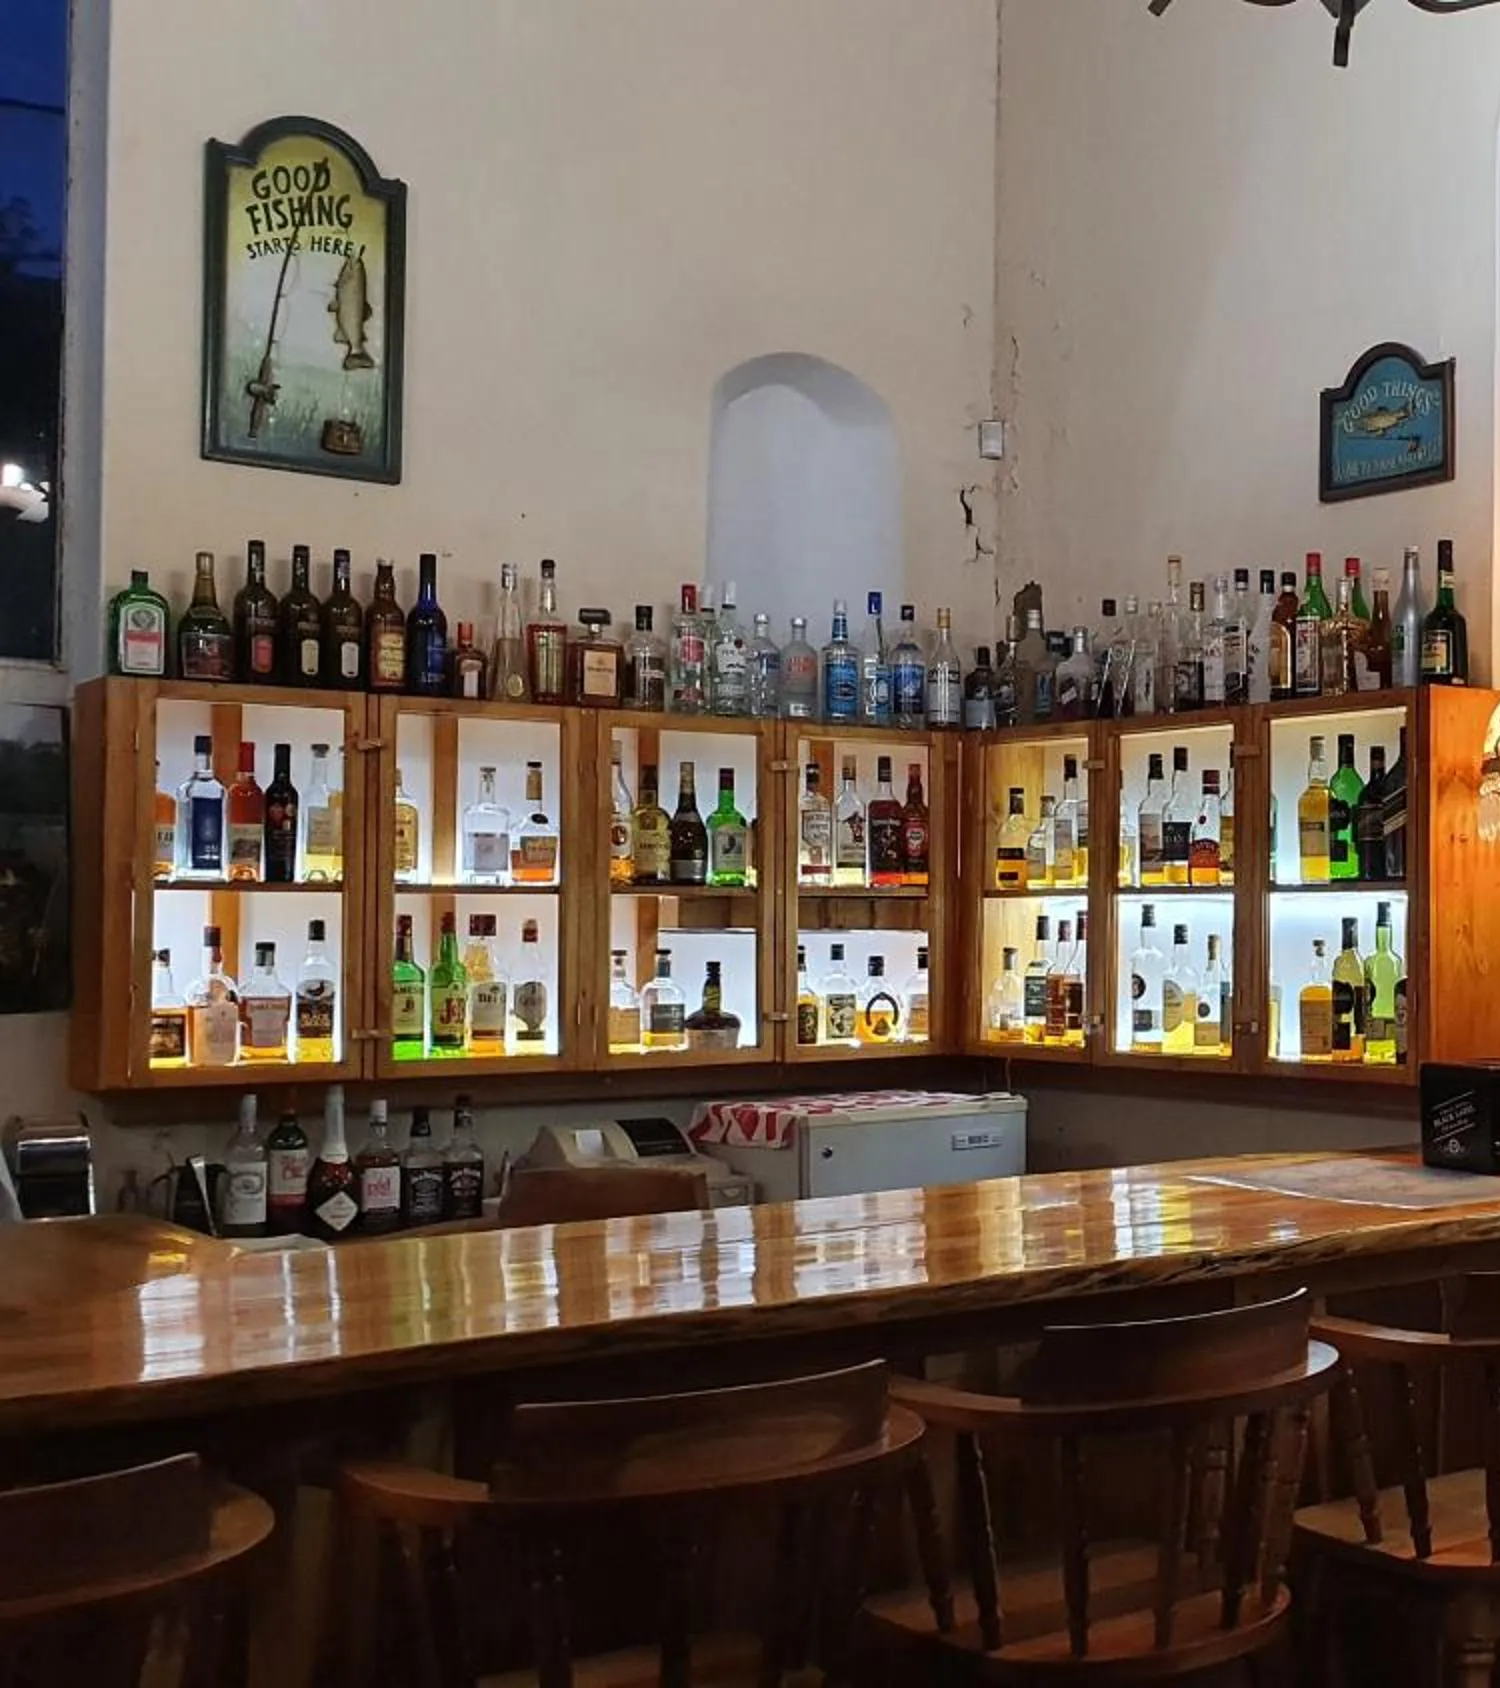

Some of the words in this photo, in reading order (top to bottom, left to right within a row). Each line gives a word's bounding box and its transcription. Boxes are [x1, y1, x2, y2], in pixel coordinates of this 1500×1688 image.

[251, 161, 331, 199] GOOD
[245, 195, 353, 235] FISHING
[247, 239, 301, 259] STARTS
[1342, 386, 1378, 433] GOOD
[1381, 380, 1434, 416] THINGS
